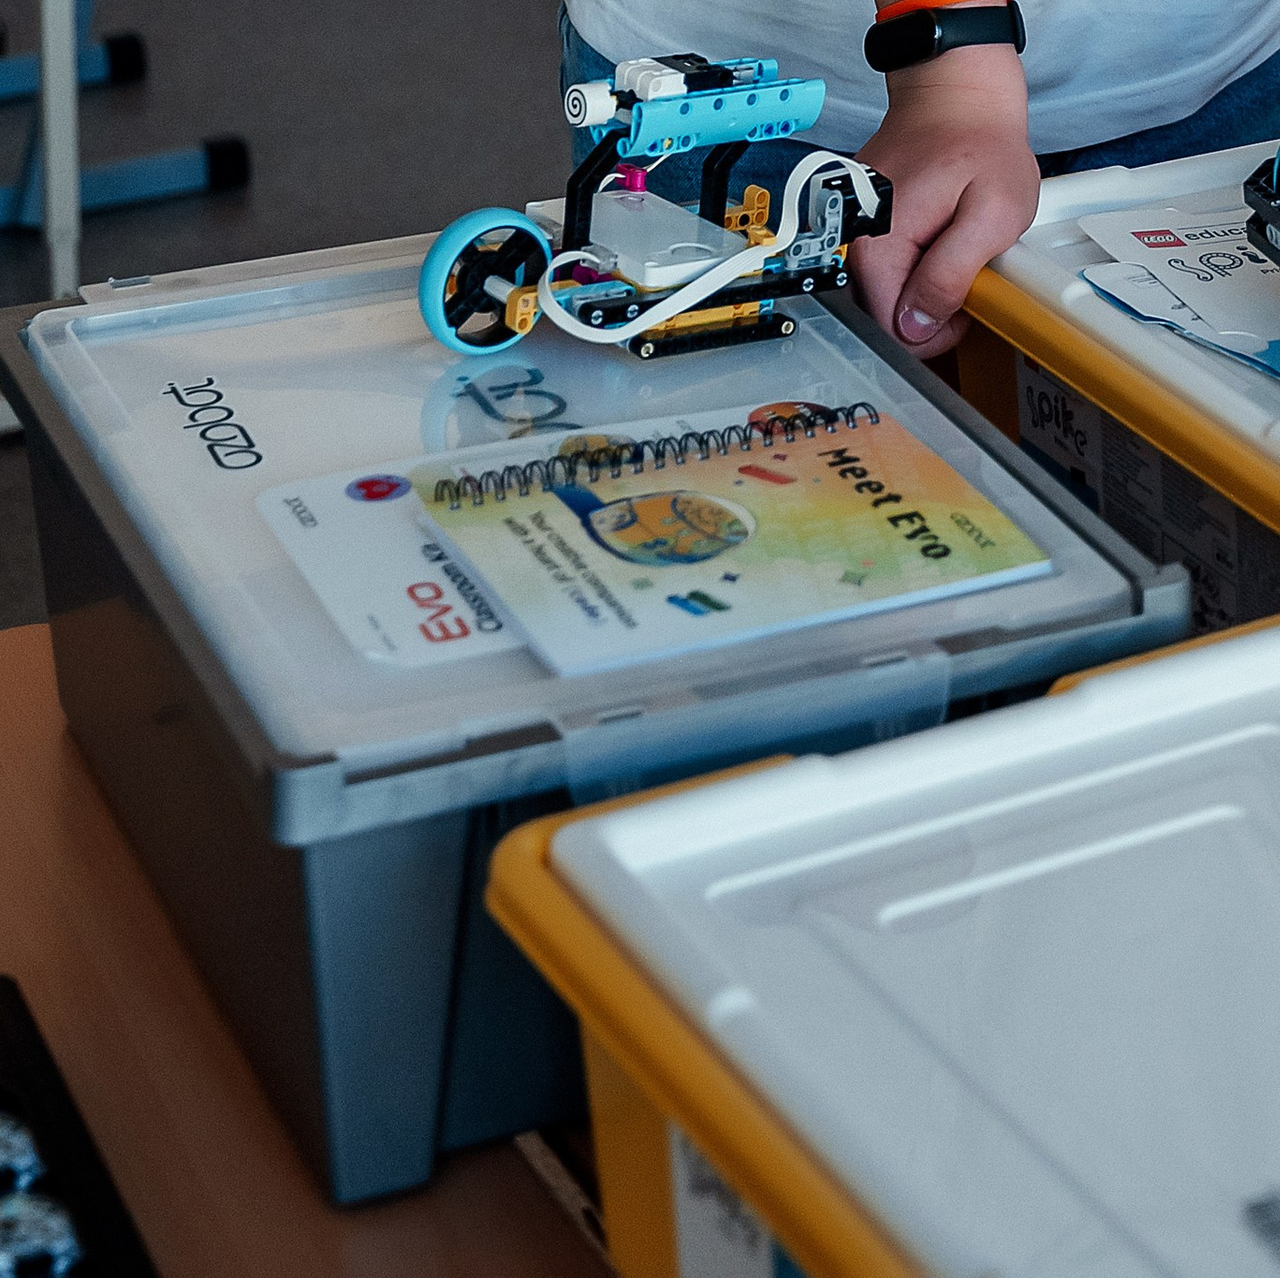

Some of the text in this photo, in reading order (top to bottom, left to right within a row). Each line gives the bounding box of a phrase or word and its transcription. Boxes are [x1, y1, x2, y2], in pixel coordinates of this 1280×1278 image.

[1184, 226, 1248, 242] educa
[817, 447, 952, 560] Meet Evo
